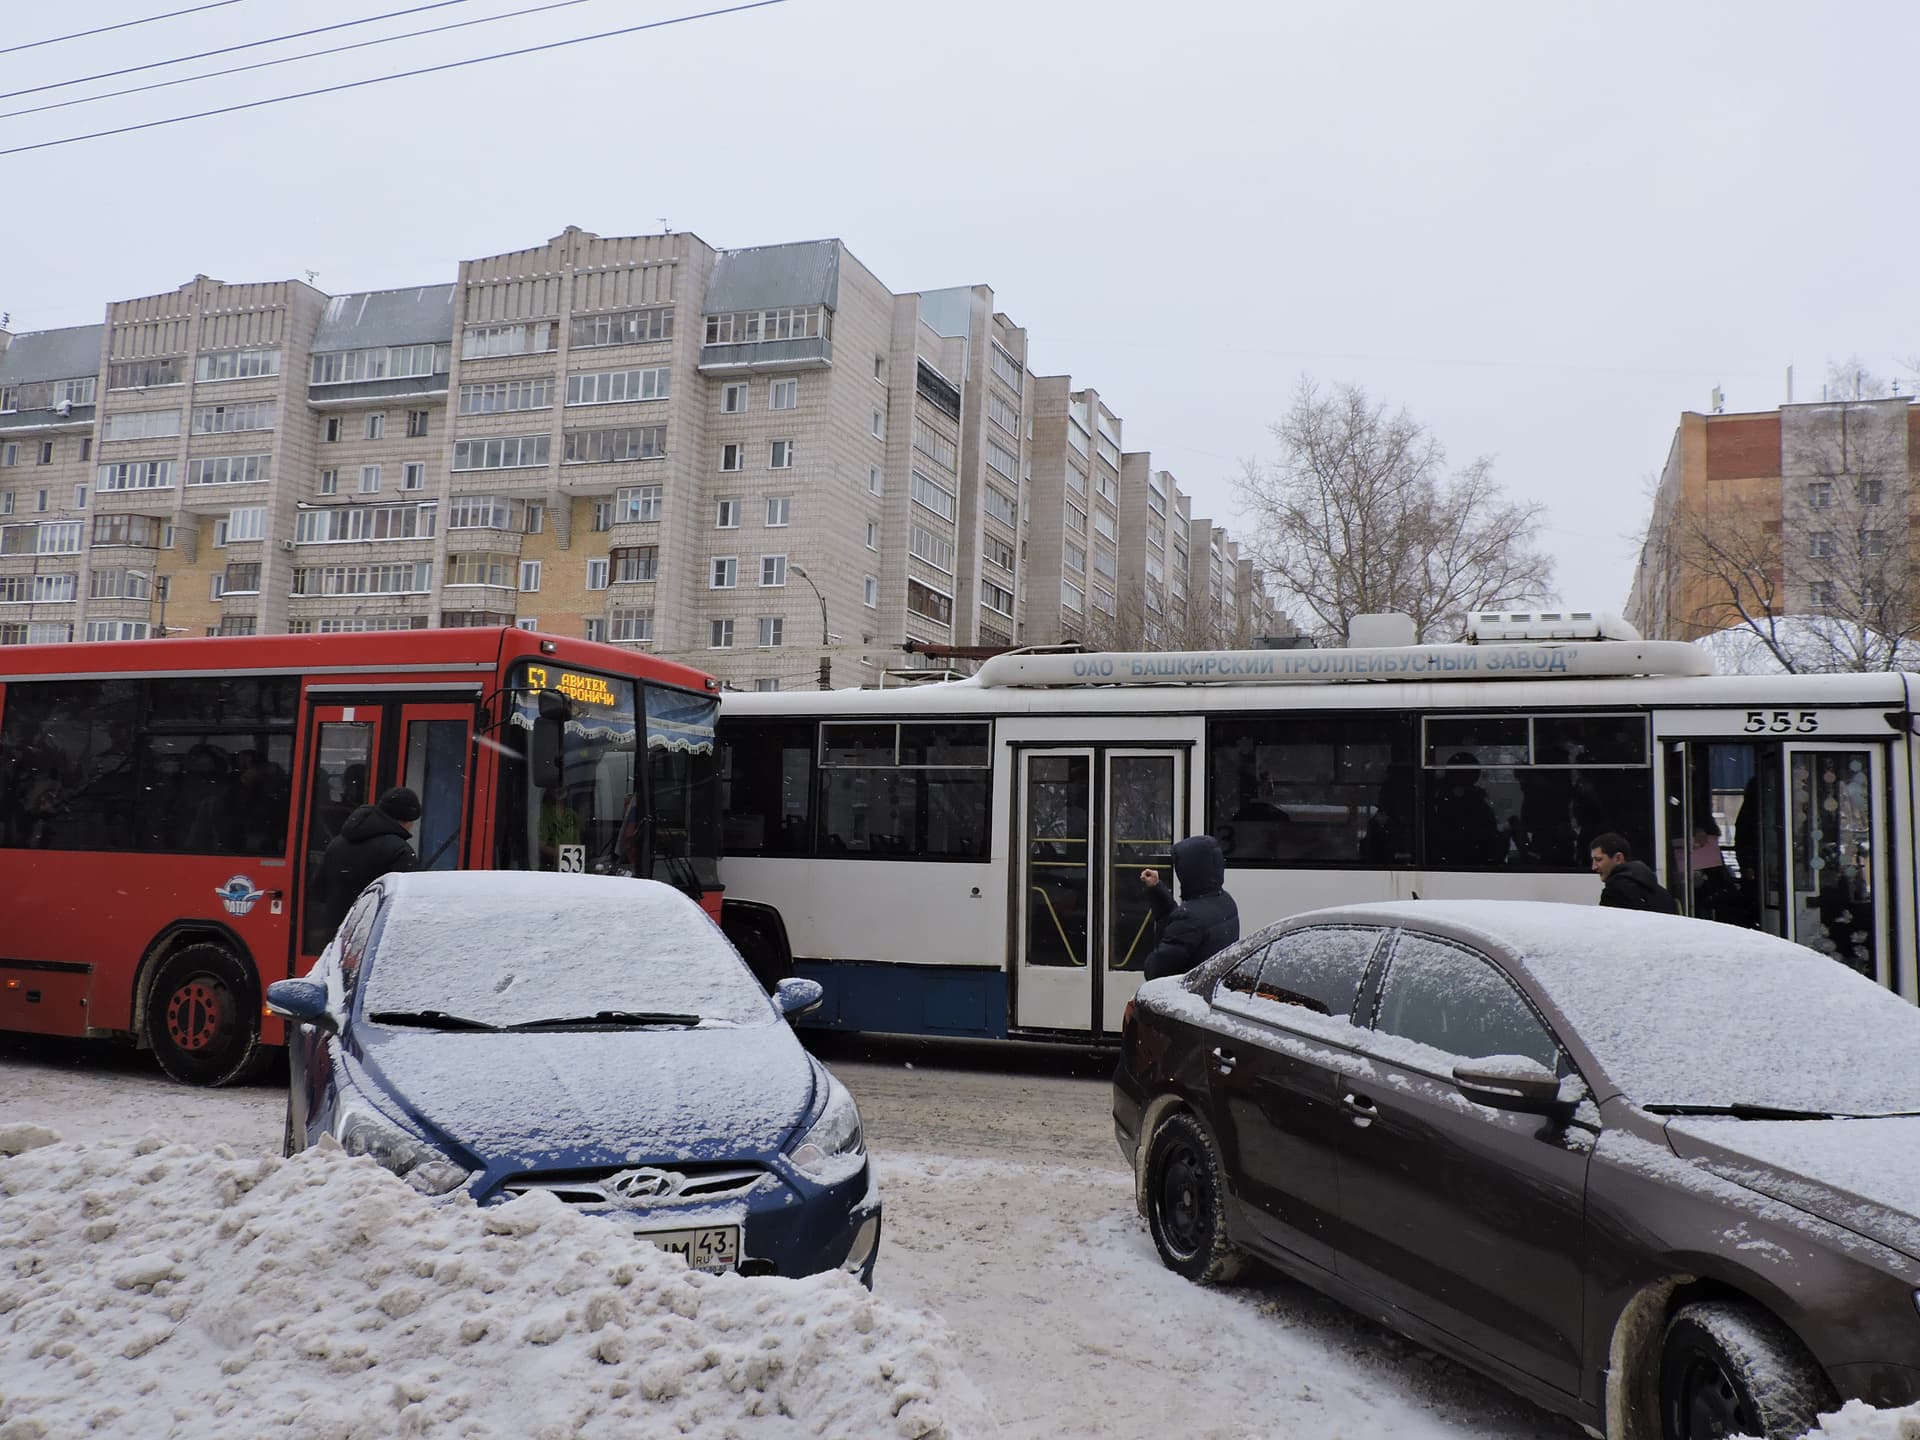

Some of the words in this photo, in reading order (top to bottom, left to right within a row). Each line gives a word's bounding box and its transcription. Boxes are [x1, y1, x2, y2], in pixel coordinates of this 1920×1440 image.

[1073, 659, 1114, 677] ОАО
[528, 667, 546, 695] 53
[561, 673, 607, 691] АВИТЕК
[1744, 711, 1818, 733] 555
[560, 847, 583, 873] 53
[699, 1231, 727, 1254] 43
[696, 1255, 714, 1264] RU
